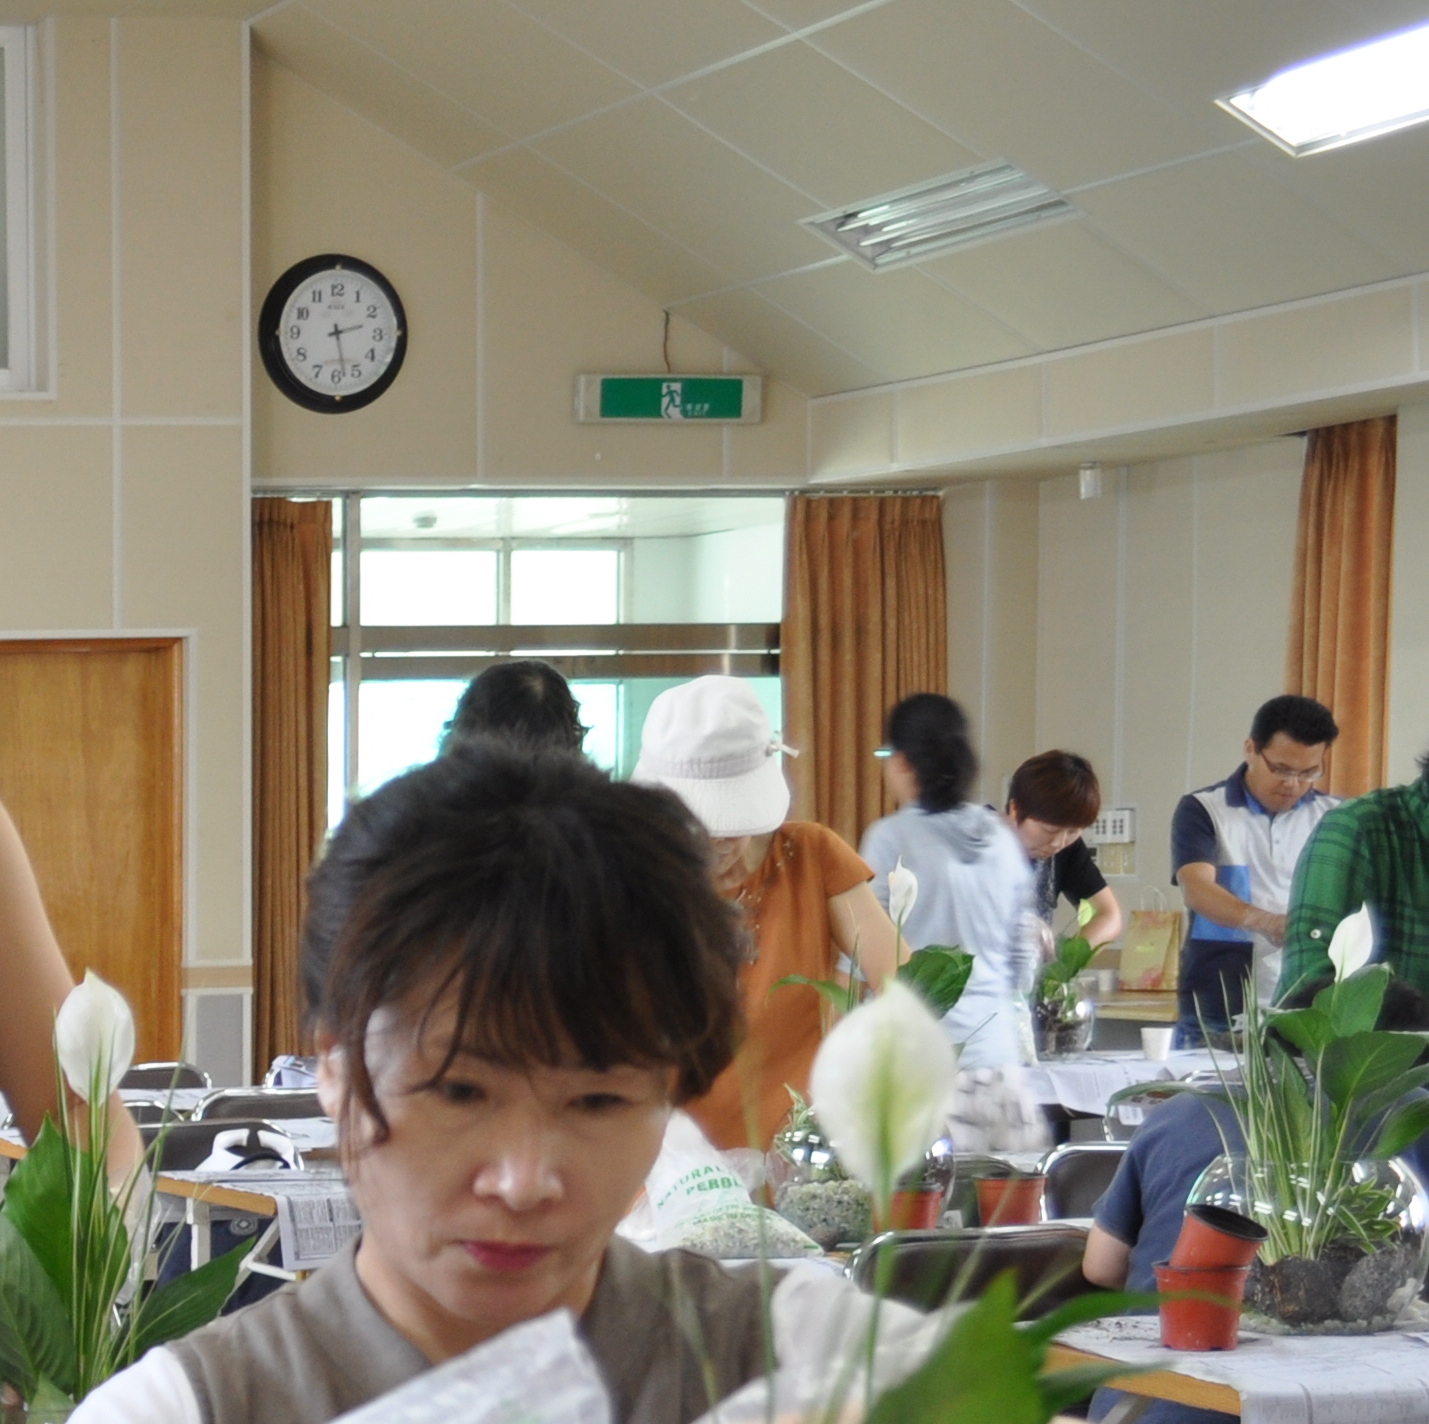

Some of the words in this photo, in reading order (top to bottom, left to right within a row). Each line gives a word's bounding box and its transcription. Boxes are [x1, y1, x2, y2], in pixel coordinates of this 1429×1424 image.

[311, 290, 322, 303] 11
[331, 283, 345, 297] 12
[354, 290, 361, 303] 1
[297, 307, 309, 320] 10
[366, 305, 377, 319] 2
[290, 325, 300, 339] 9
[372, 328, 383, 342] 3
[296, 347, 307, 362] 8
[364, 347, 376, 362] 4
[312, 364, 323, 379] 7
[331, 369, 342, 384] 6
[351, 364, 362, 378] 5
